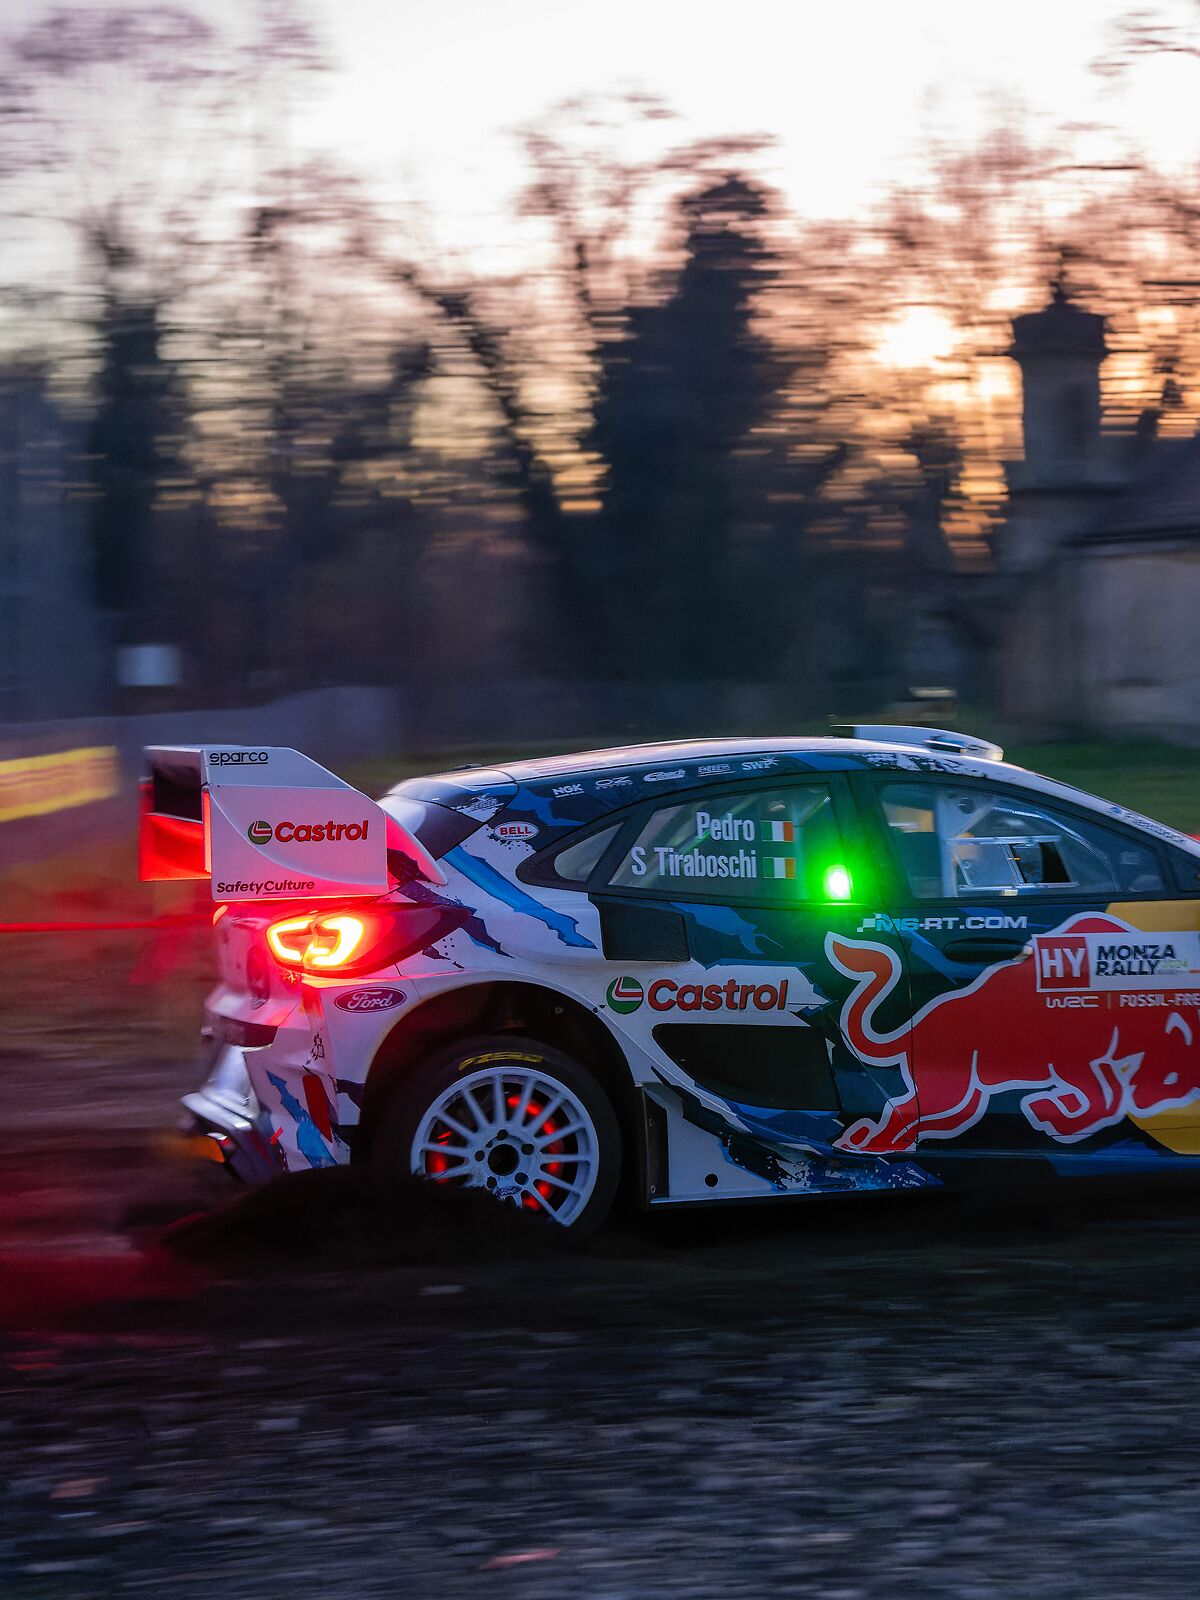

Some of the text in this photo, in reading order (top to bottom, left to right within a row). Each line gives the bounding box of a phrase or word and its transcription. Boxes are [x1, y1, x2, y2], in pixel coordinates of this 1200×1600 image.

[209, 751, 269, 767] sparco
[552, 783, 584, 796] NGK
[275, 819, 369, 844] Castrol
[499, 826, 532, 836] BELL
[696, 811, 756, 841] Pedro
[630, 846, 757, 878] S Tiraboschi
[216, 879, 316, 895] SafetyCulture
[1097, 944, 1177, 961] MONZA
[1039, 946, 1087, 978] HY
[1096, 960, 1160, 976] RALLY
[347, 990, 394, 1010] Ford
[647, 978, 789, 1012] Castrol
[1045, 995, 1100, 1009] WRC
